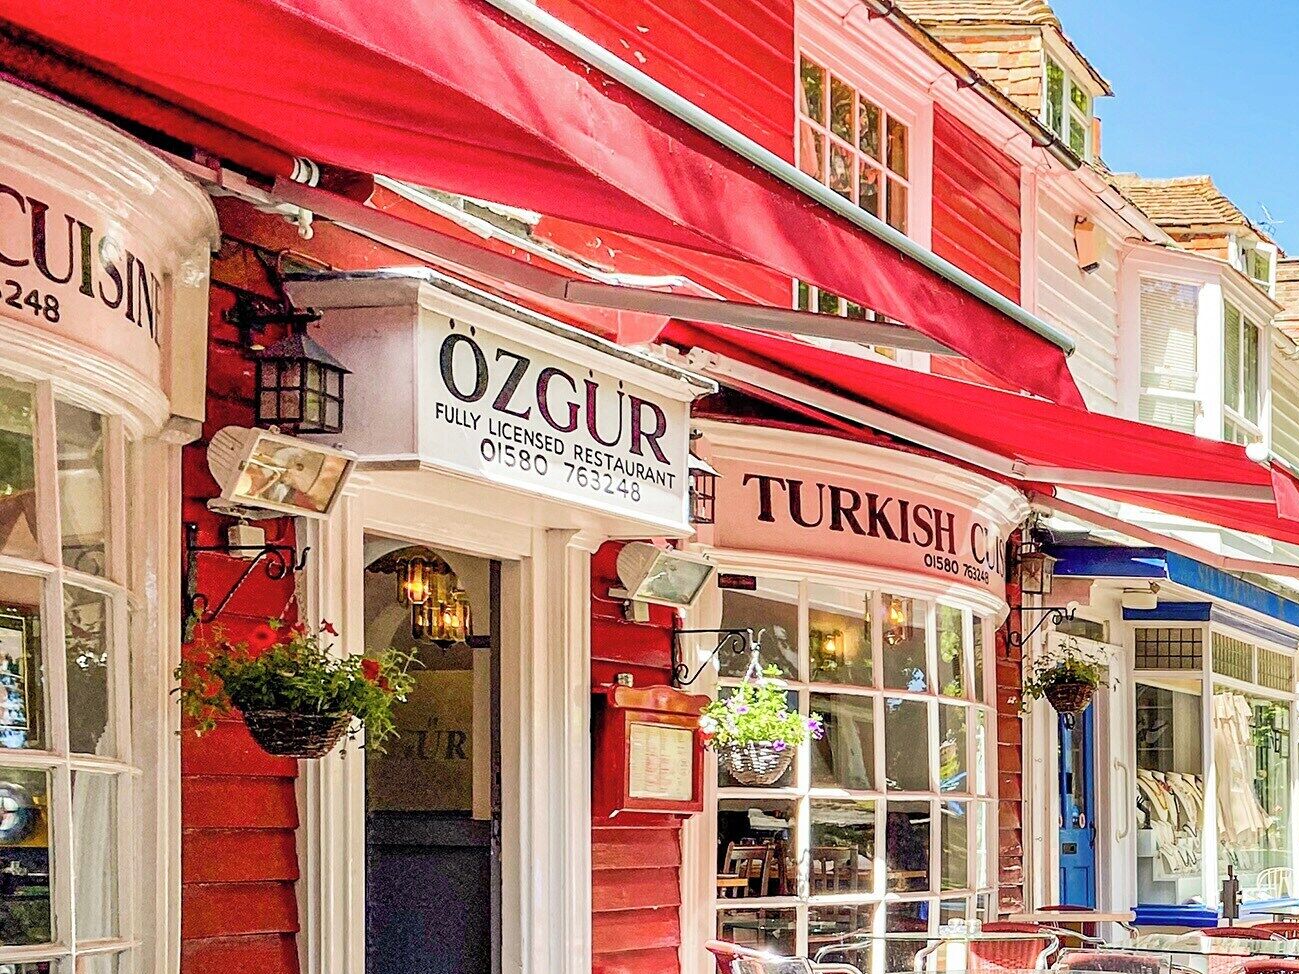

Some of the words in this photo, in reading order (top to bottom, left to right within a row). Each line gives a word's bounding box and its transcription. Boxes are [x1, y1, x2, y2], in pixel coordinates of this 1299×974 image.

[0, 279, 60, 323] 248
[439, 318, 671, 465] ÖZGÜR
[436, 402, 482, 431] FULLY
[489, 418, 565, 456] LICENSED
[574, 444, 676, 489] RESTAURANT
[480, 438, 548, 476] 01580
[563, 462, 641, 502] 763248
[742, 473, 956, 555] TURKISH
[924, 553, 959, 575] 01580
[962, 563, 990, 585] 763248
